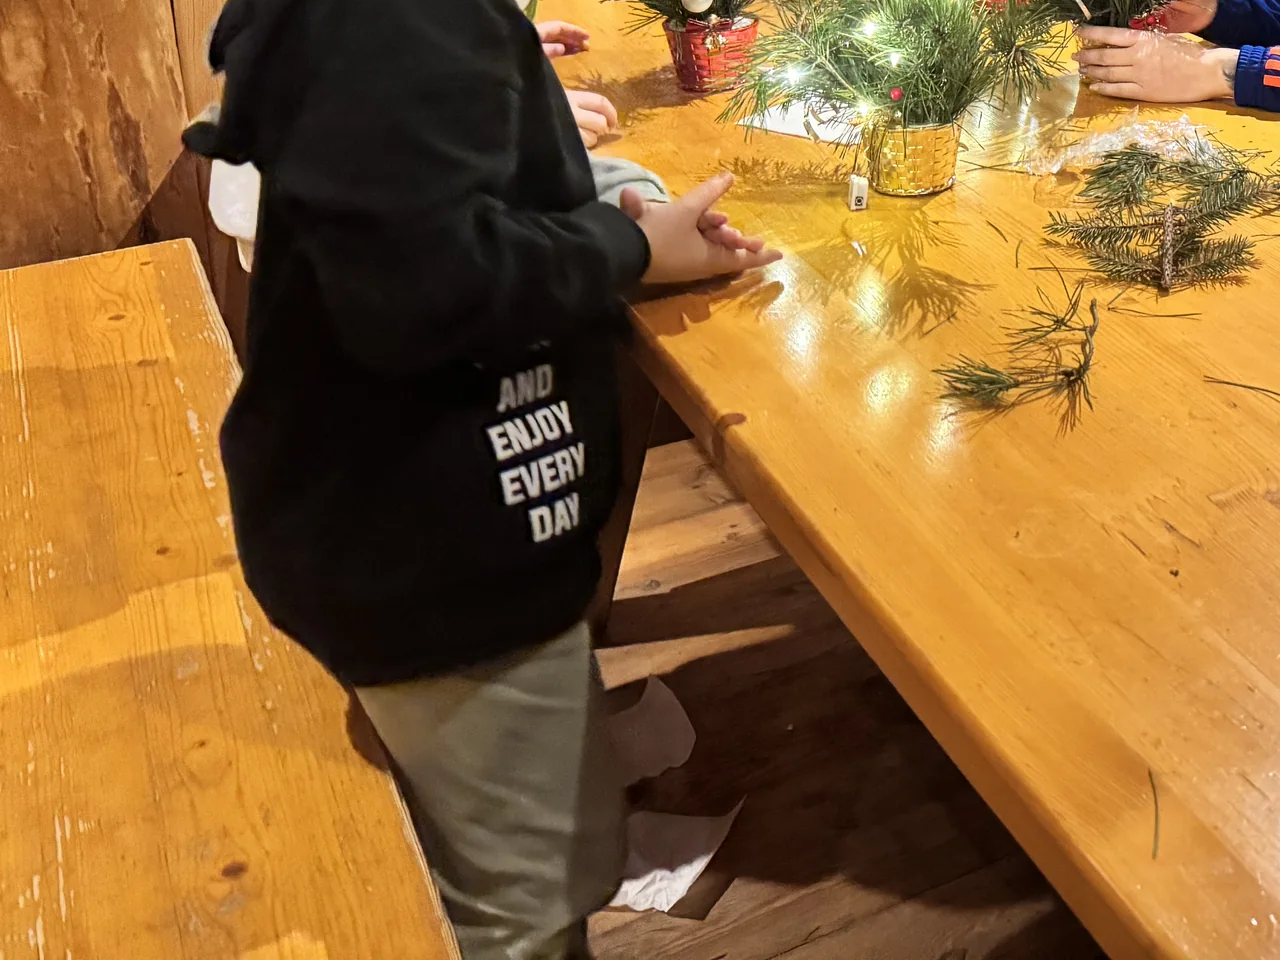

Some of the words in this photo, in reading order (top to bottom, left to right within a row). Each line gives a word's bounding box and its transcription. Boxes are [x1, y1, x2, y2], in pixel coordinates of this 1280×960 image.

[496, 363, 554, 413] AND
[486, 400, 574, 461] ENJOY
[498, 442, 585, 506] EVERY
[528, 492, 580, 543] DAY
